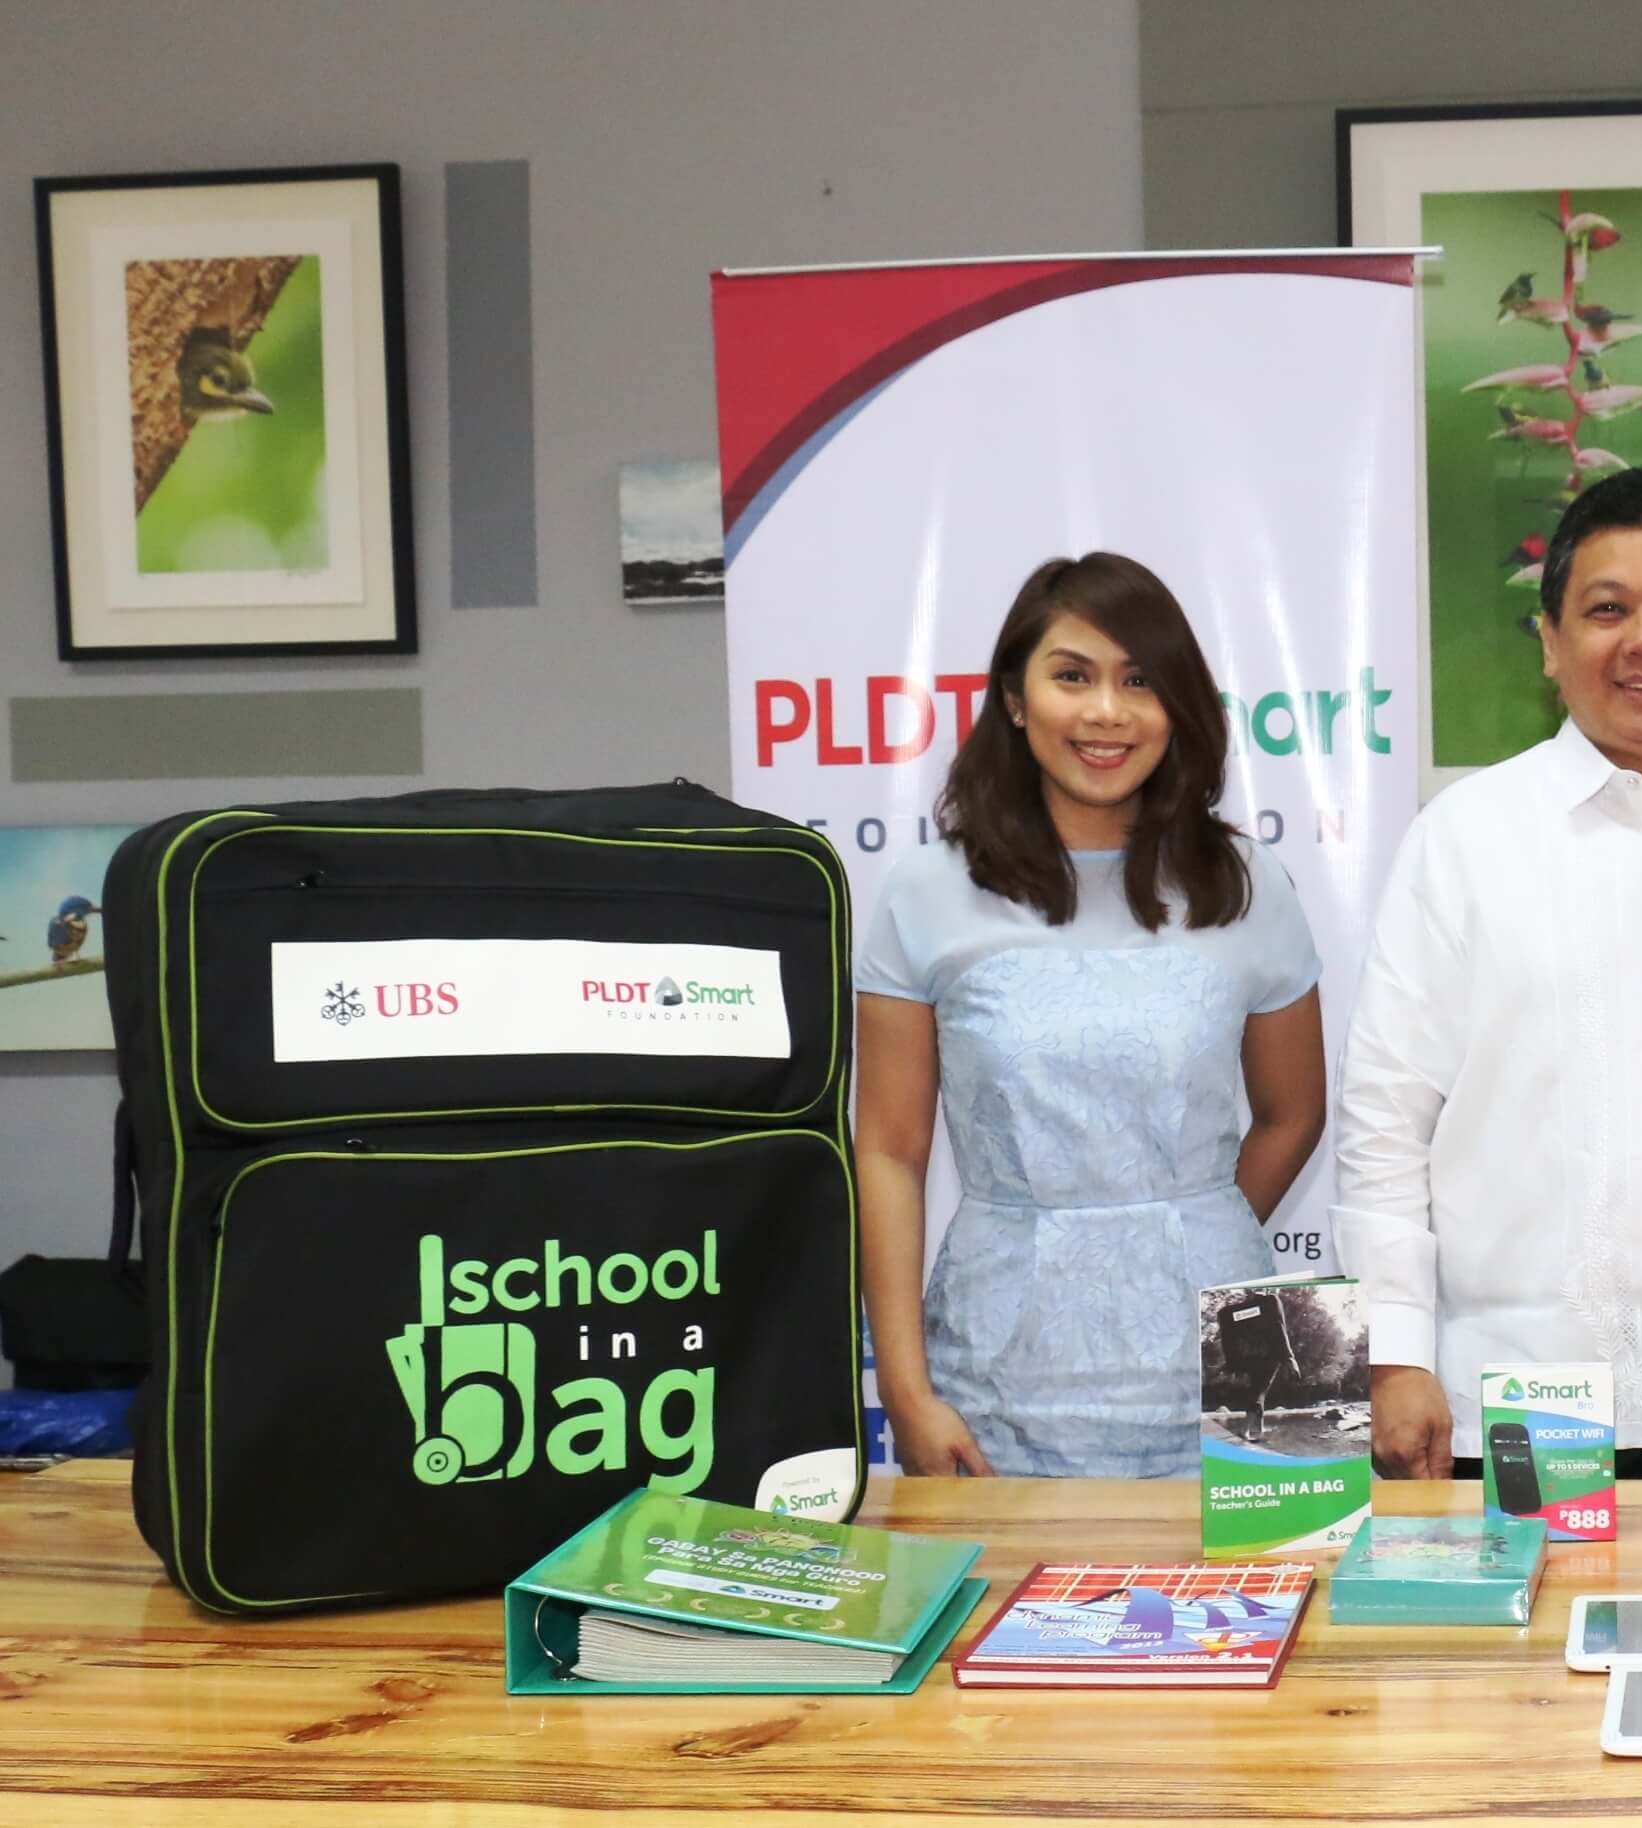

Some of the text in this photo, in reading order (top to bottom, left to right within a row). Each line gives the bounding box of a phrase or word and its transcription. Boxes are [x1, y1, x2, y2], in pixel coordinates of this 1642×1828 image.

[755, 672, 992, 768] PLDT
[374, 981, 460, 1019] UBS
[581, 979, 756, 1007] PLDT Smart
[607, 1010, 740, 1022] FOUNDATION
[448, 1229, 721, 1315] school
[579, 1324, 704, 1361] in a
[1527, 1380, 1593, 1399] Smart
[1577, 1401, 1595, 1410] Bro
[1535, 1428, 1605, 1440] POCKET WIFI
[789, 1488, 838, 1511] Smart
[1210, 1479, 1345, 1500] SCHOOL IN A BAG
[1210, 1498, 1281, 1511] Teacher's Guide
[647, 1536, 887, 1582] GABAY Sa PANONOOD
[657, 1546, 713, 1563] Para
[718, 1556, 747, 1570] Sa
[749, 1560, 801, 1578] Mga
[805, 1571, 861, 1587] Guro
[750, 1588, 825, 1607] Smart
[1149, 1653, 1206, 1663] Version
